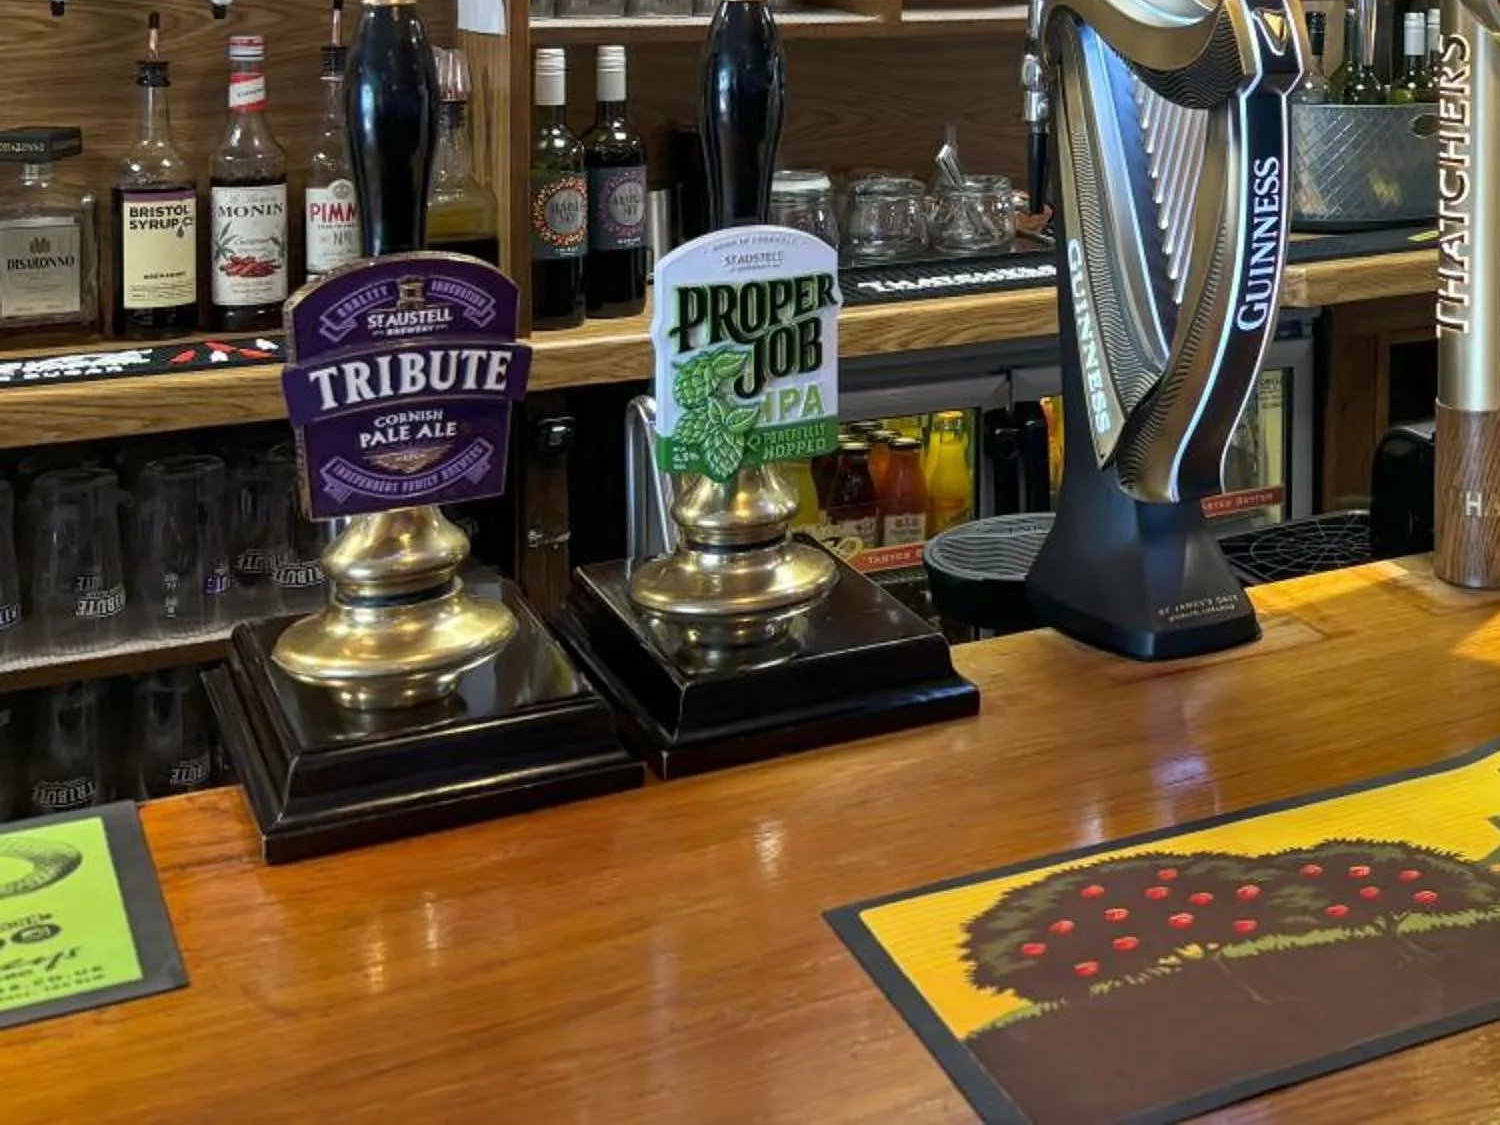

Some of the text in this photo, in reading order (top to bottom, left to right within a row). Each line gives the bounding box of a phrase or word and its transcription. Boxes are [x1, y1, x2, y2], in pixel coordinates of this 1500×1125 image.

[1436, 32, 1472, 339] THATCHERS
[129, 205, 190, 219] BRISTOL
[217, 201, 284, 218] MONIN
[309, 201, 357, 223] PIMM
[129, 218, 178, 231] SYRUP
[1235, 154, 1281, 332] GUINNESS
[367, 306, 454, 330] ST AUSTELL
[667, 272, 839, 355] PROPER
[1065, 237, 1113, 436] GUINNESS
[732, 315, 824, 401] JOB
[308, 348, 513, 412] TRIBUTE
[759, 383, 826, 424] IPA
[373, 408, 445, 429] CORNISH
[358, 421, 458, 449] PALE ALE
[762, 437, 828, 462] HOPPED
